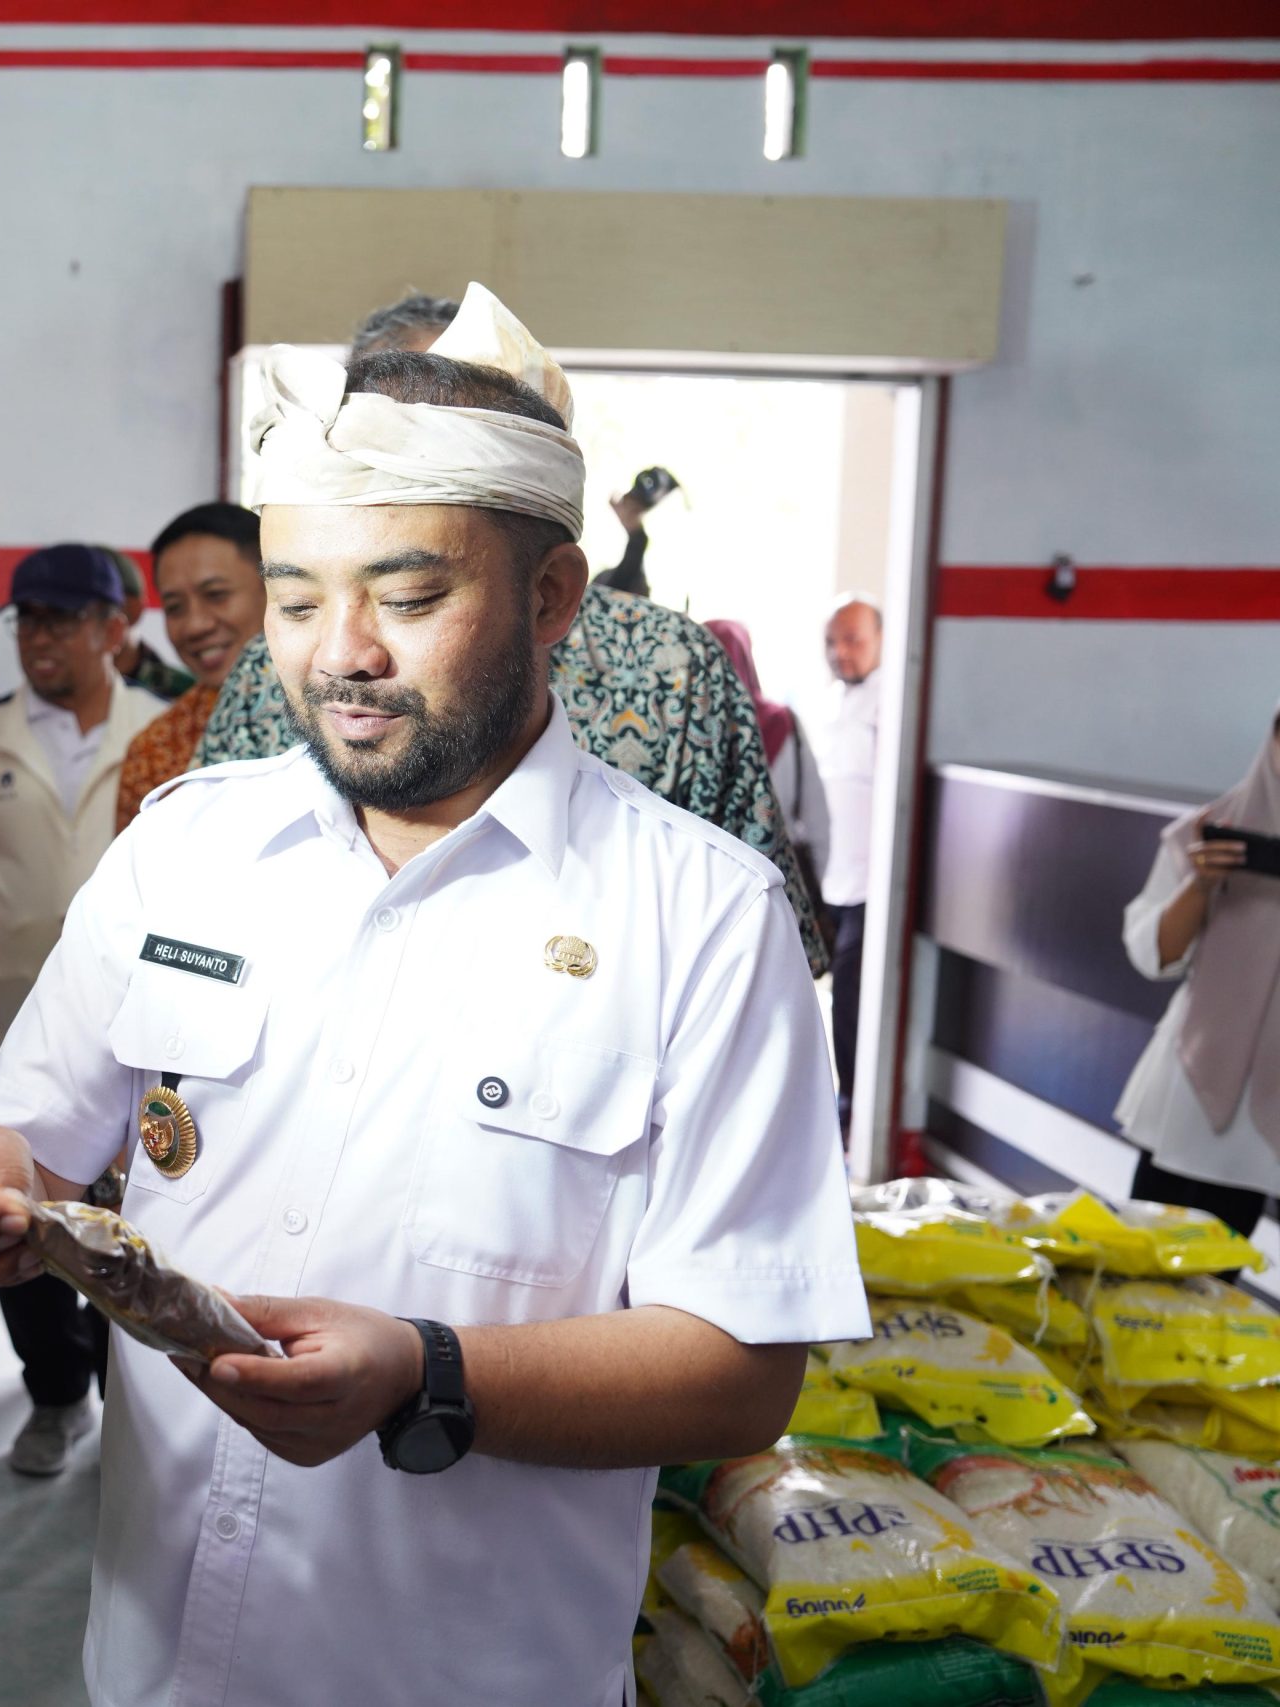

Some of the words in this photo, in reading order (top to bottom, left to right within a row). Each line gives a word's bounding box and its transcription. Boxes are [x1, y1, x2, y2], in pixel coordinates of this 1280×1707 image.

[154, 943, 178, 960] HELI
[180, 950, 228, 972] SUYANTO
[1032, 1542, 1186, 1578] SPHP
